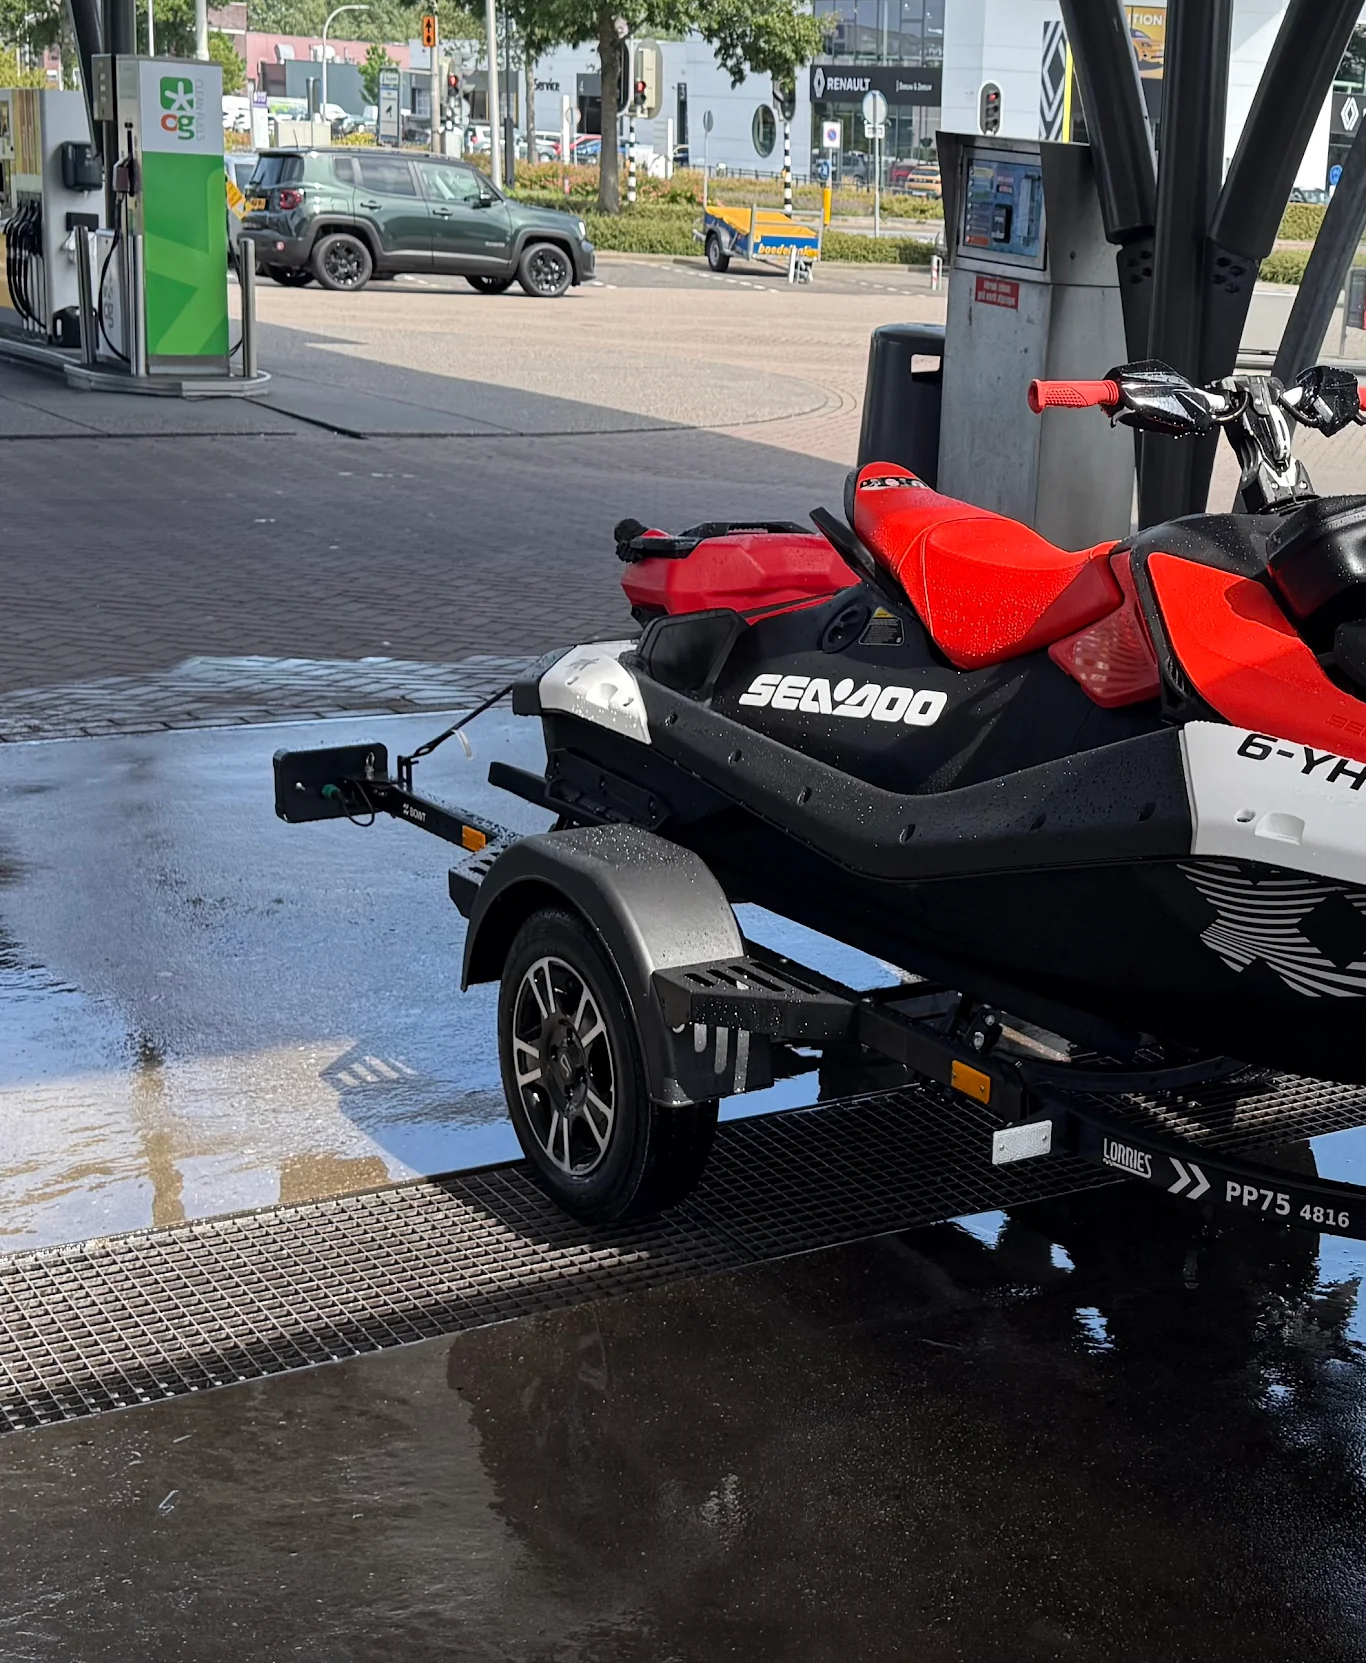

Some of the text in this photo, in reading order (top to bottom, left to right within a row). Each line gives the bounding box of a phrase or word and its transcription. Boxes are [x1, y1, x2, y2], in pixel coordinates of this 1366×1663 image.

[534, 78, 560, 93] Service
[579, 80, 584, 93] 4
[679, 84, 685, 100] 3
[826, 76, 871, 92] RENAULT
[1102, 1137, 1152, 1179] LORRIES
[1225, 1180, 1351, 1228] PP75 4816
